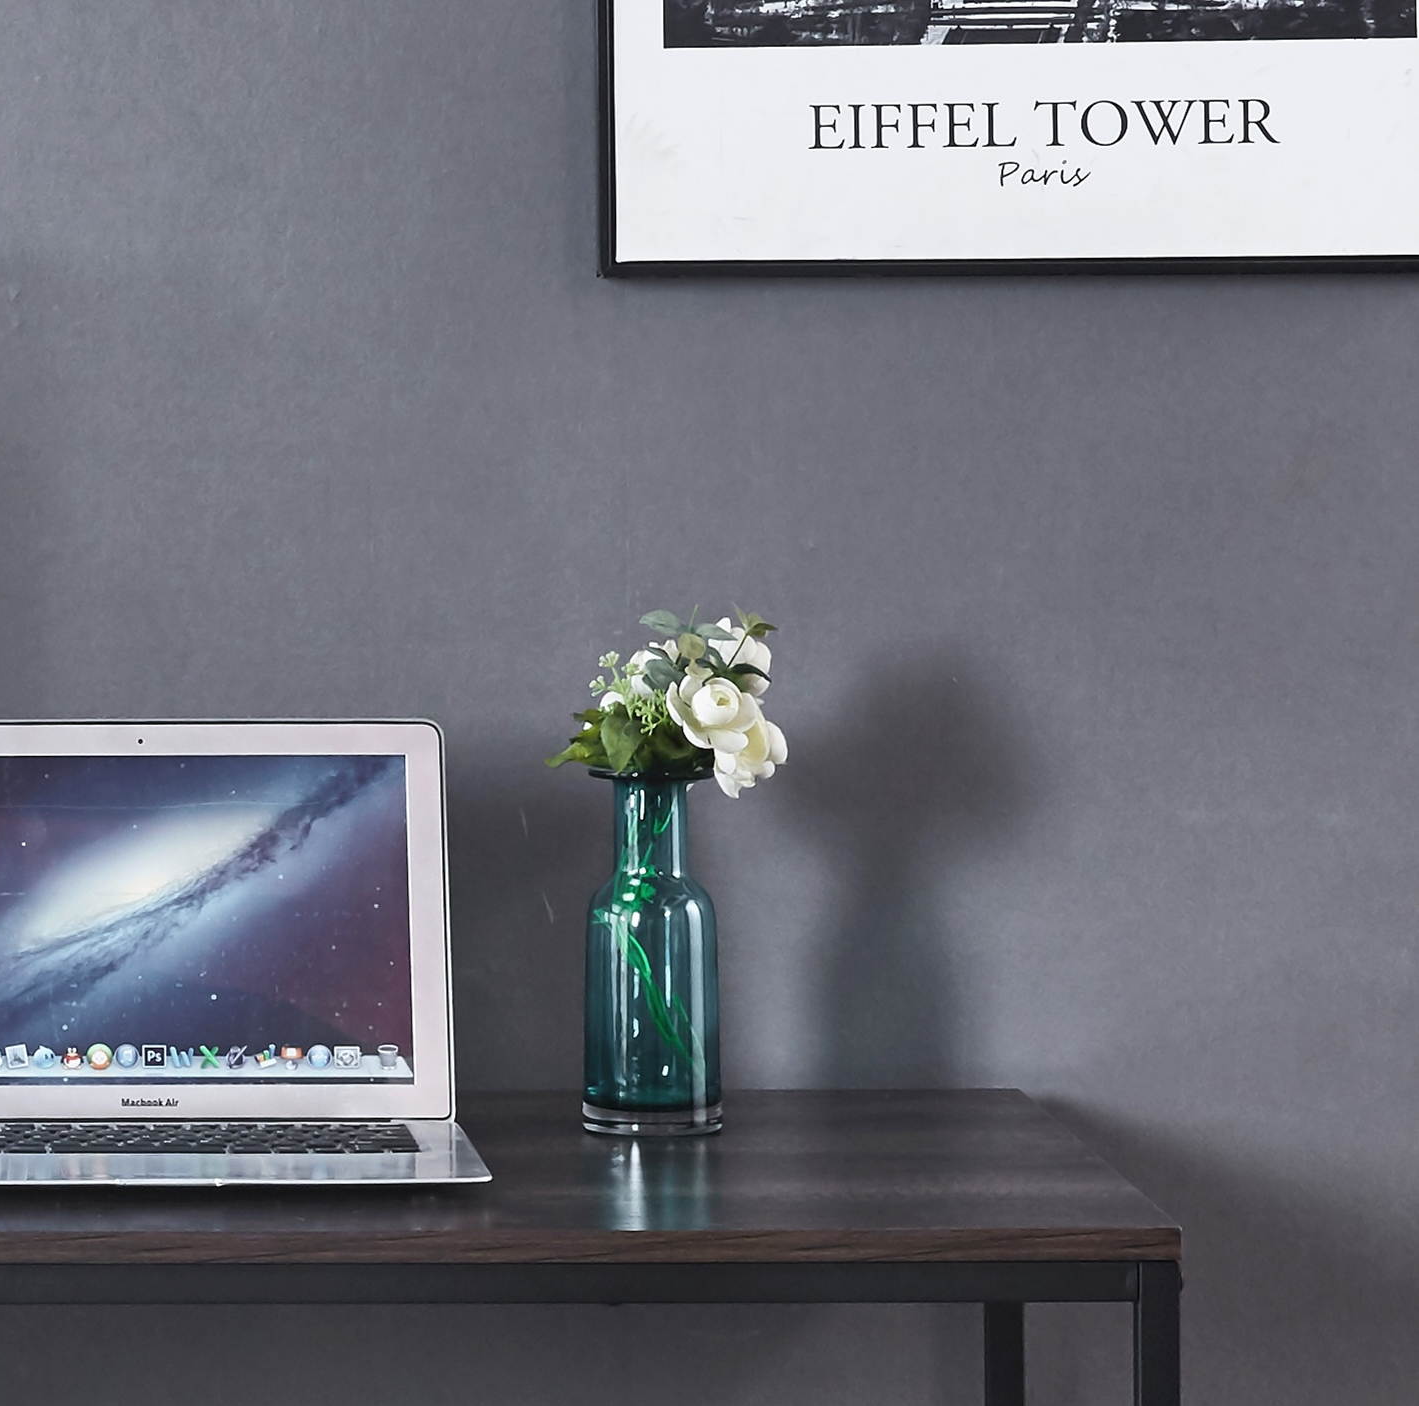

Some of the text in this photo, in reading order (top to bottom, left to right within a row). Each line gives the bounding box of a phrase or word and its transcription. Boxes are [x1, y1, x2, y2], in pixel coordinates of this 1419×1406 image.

[808, 98, 1281, 150] EIFFEL TOWER
[998, 159, 1092, 187] Paris
[147, 1050, 162, 1062] Ps
